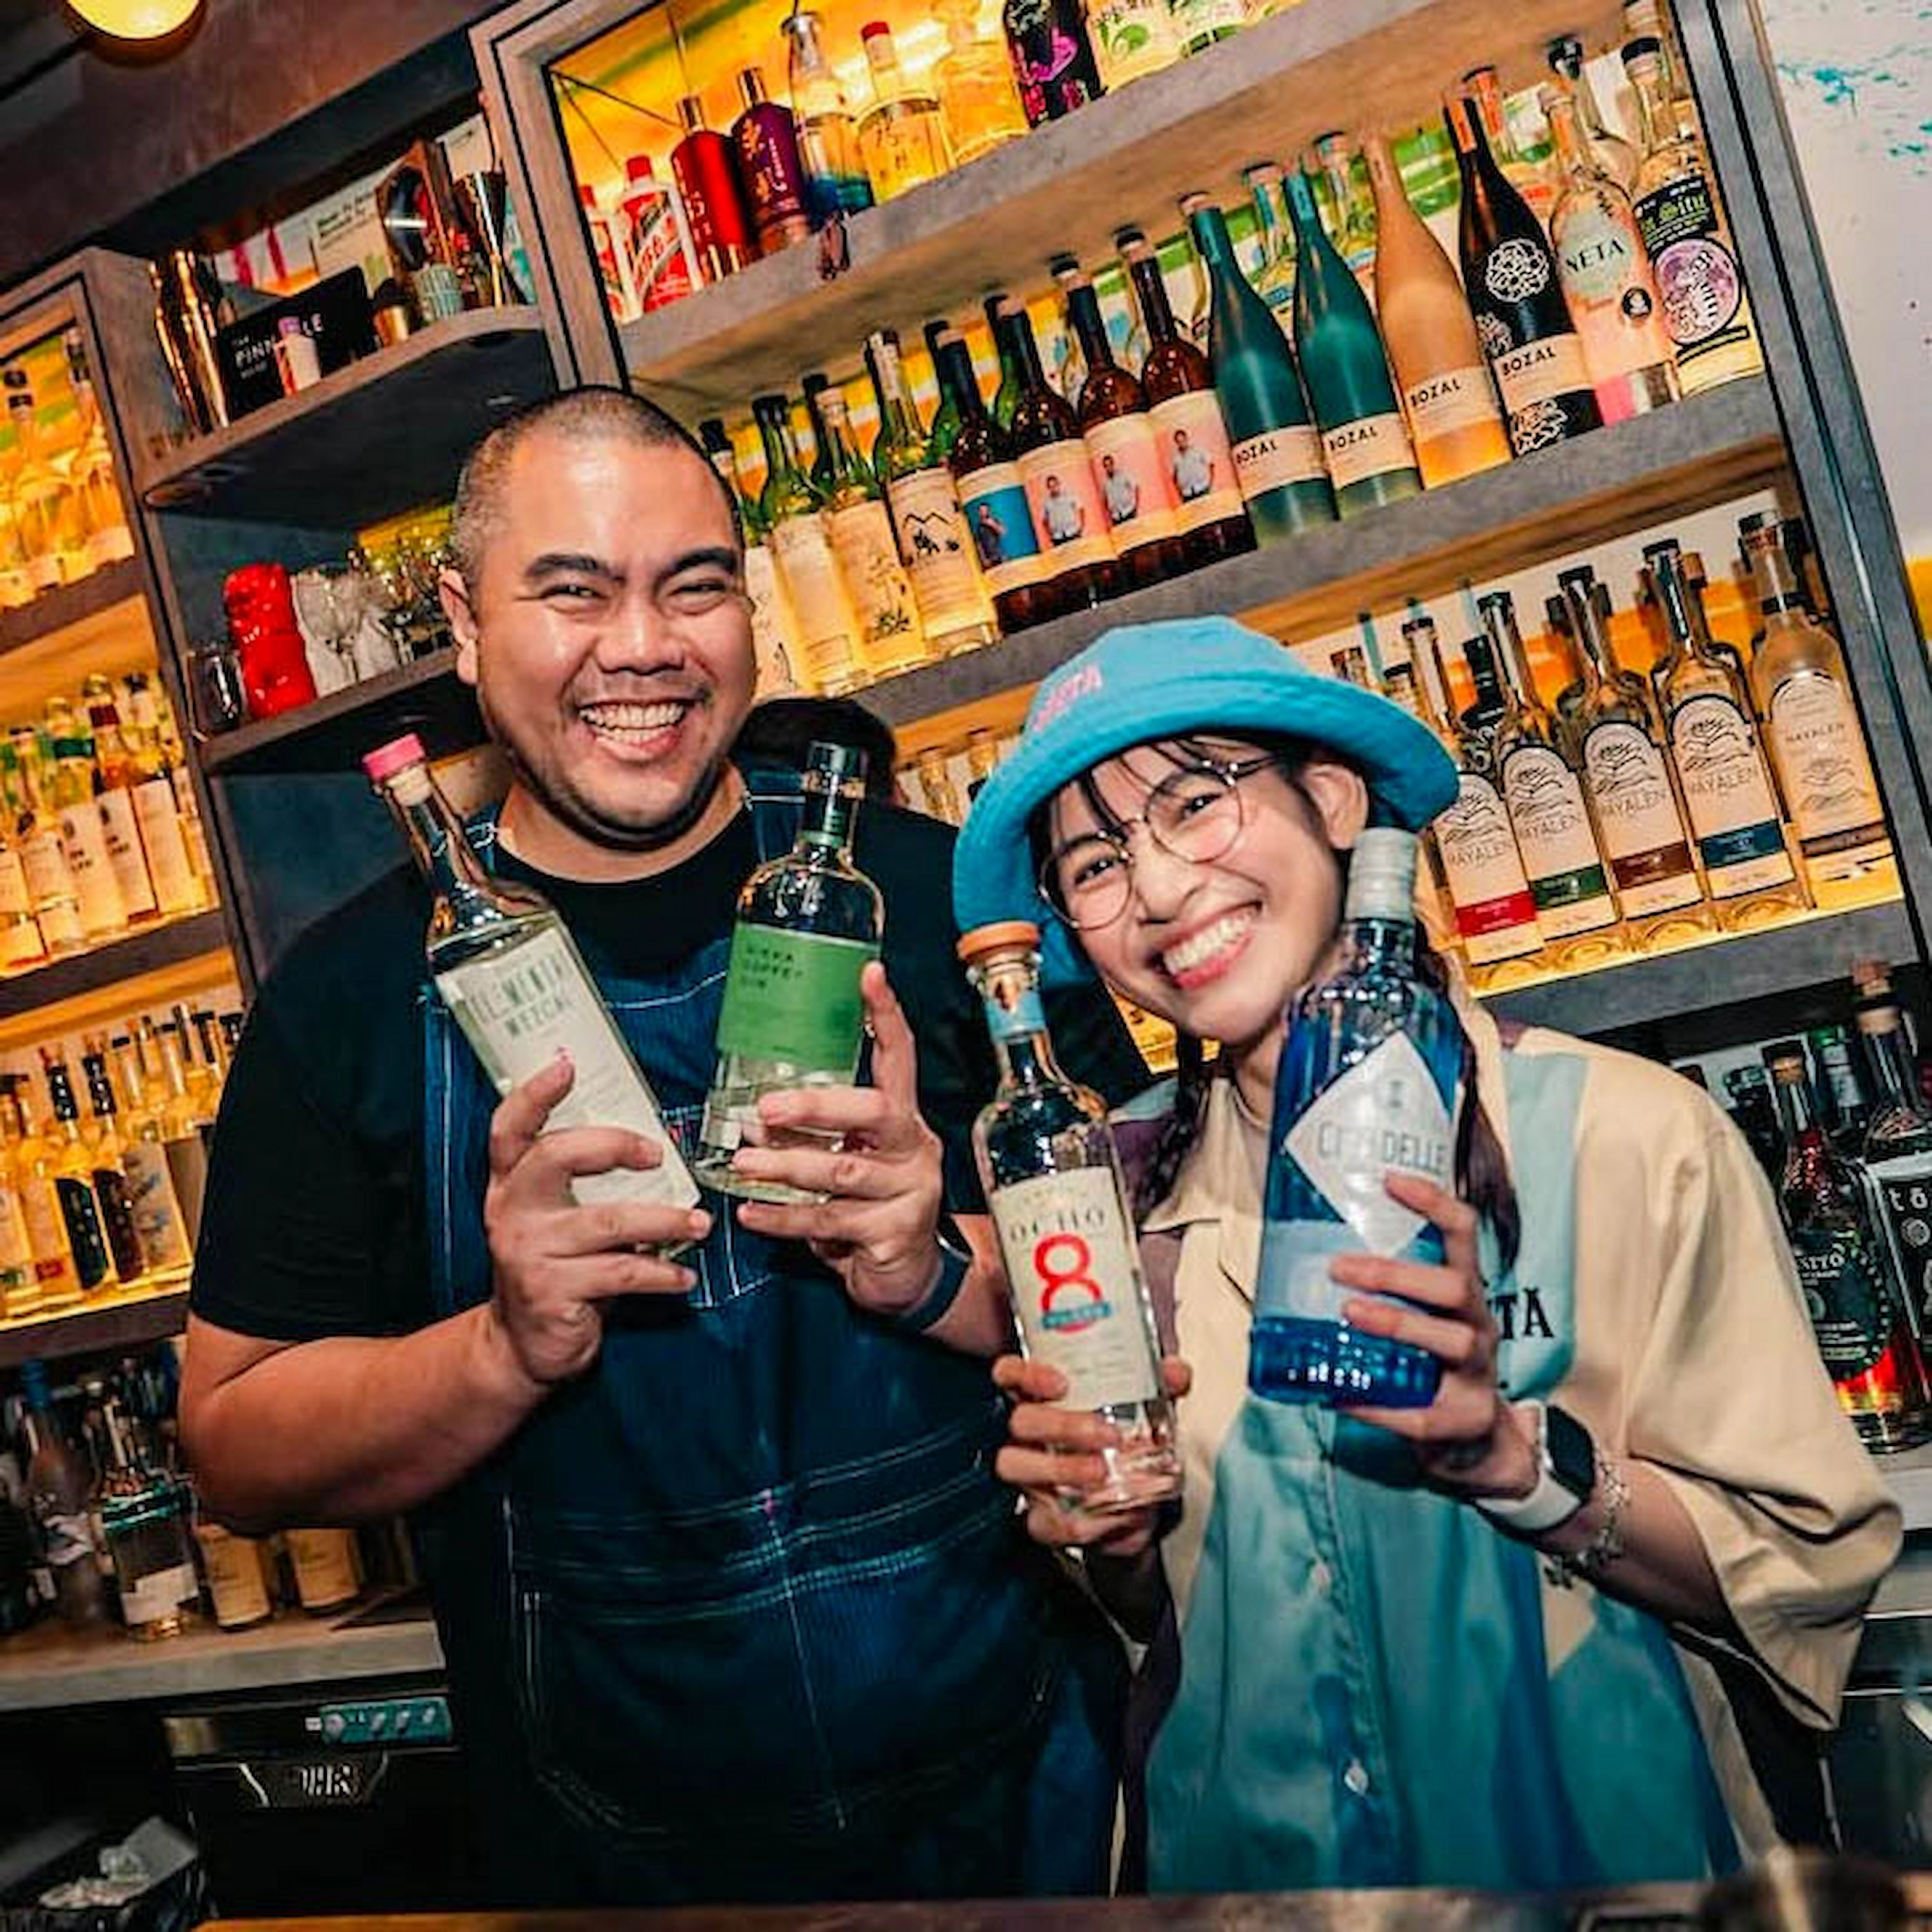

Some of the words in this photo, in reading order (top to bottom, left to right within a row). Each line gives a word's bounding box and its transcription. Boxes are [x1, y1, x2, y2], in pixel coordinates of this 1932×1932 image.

[1565, 235, 1625, 273] NETA
[234, 312, 325, 368] PINNLE
[1503, 346, 1556, 376] BOZAL
[1409, 377, 1461, 408] BOZAL
[1318, 1121, 1449, 1177] CIDELLE
[1485, 1287, 1555, 1340] TA
